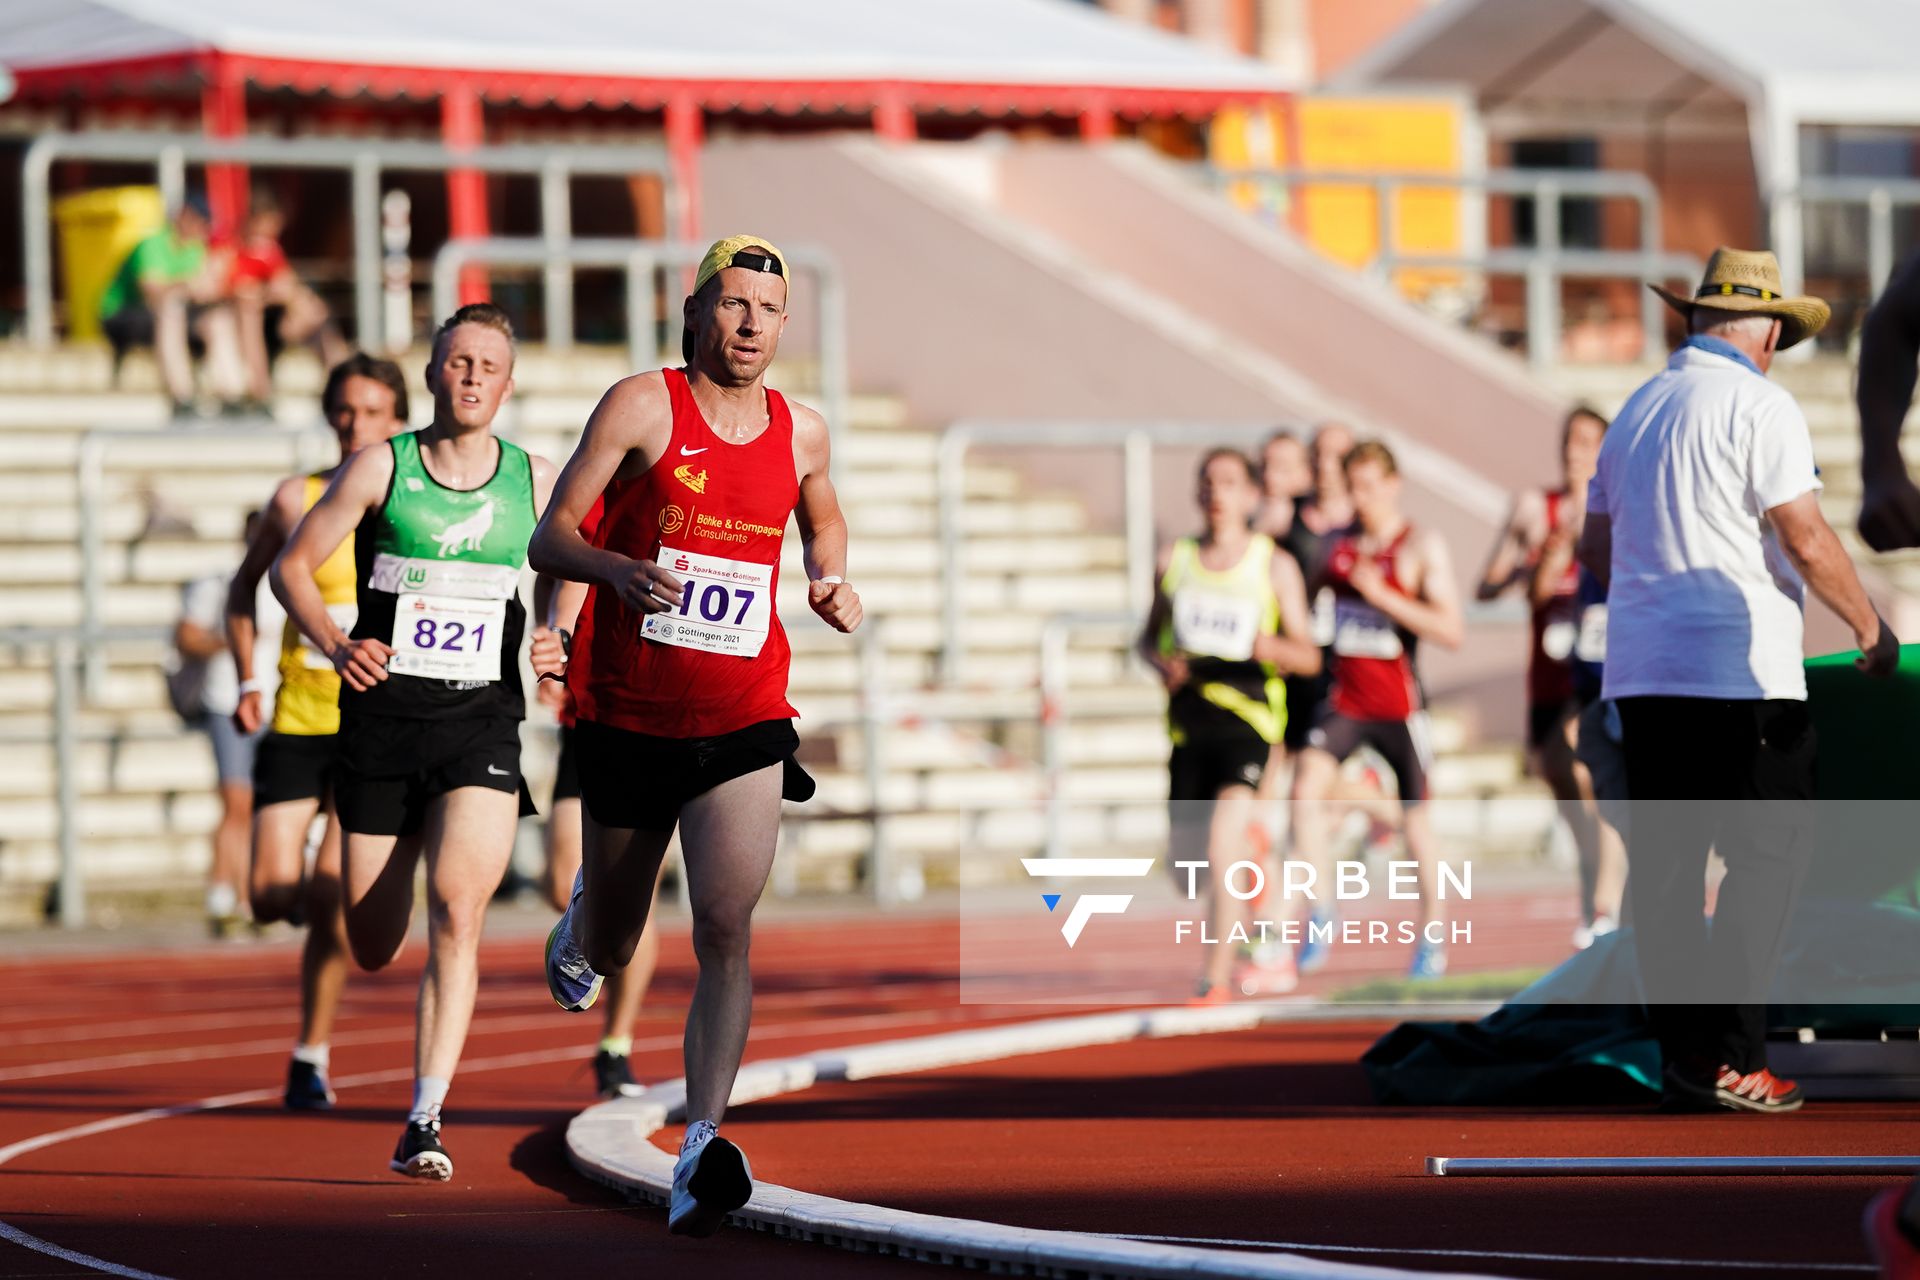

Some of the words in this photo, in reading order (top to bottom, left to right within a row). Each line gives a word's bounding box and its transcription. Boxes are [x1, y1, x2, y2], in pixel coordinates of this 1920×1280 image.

[693, 526, 748, 544] Consultants
[697, 513, 722, 528] Böhke
[725, 519, 732, 529] &
[735, 520, 783, 537] Compagnie
[692, 565, 730, 577] Sparkasse
[679, 580, 755, 625] 107
[414, 619, 485, 652] 821
[677, 626, 722, 641] Göttingen
[723, 634, 740, 643] 2021
